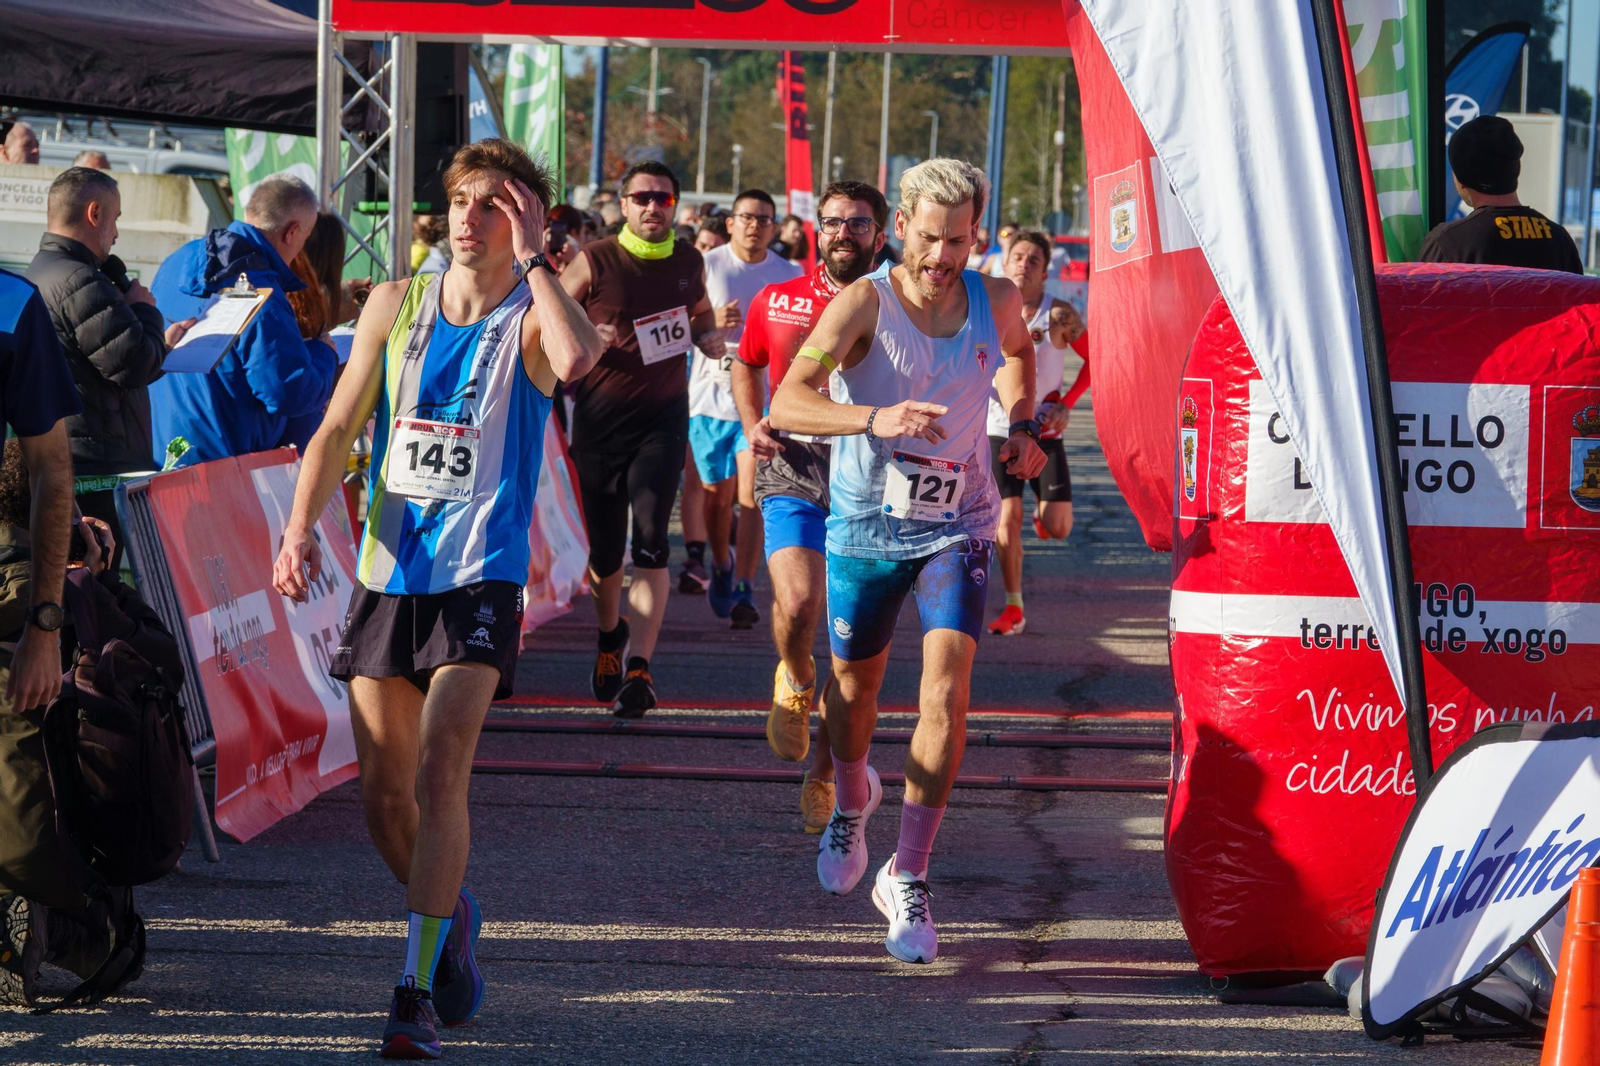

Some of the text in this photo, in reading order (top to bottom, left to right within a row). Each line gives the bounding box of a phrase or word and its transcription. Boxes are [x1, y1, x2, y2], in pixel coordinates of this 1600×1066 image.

[906, 0, 1034, 31] Cáncer
[14, 194, 44, 205] VIGO
[1495, 216, 1552, 239] STAFF
[768, 292, 813, 314] LA 21
[776, 311, 811, 323] Santander
[650, 321, 685, 346] 116
[1267, 411, 1505, 449] CELLO
[406, 440, 472, 477] 143
[907, 473, 957, 504] 121
[1402, 459, 1476, 493] IGO
[1415, 582, 1488, 625] IGO,
[1299, 617, 1567, 663] terre de xogo
[1385, 814, 1600, 938] Atlántico
